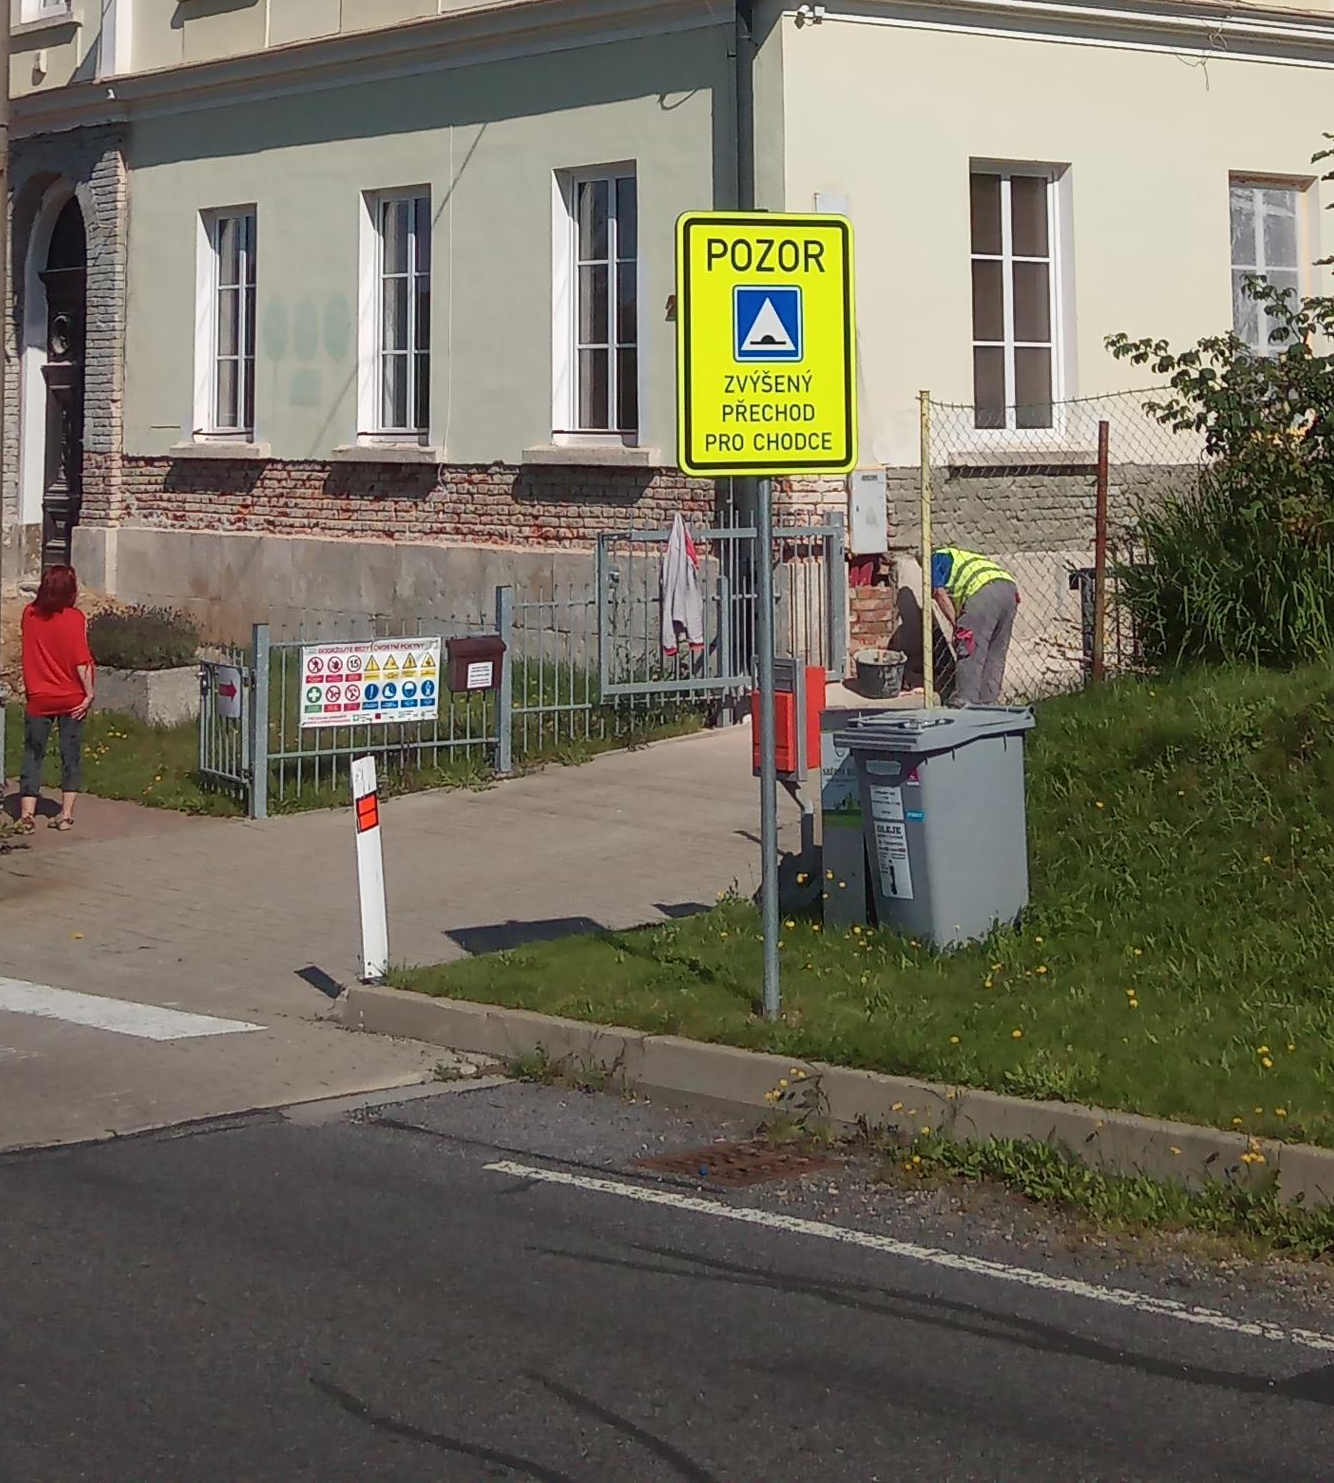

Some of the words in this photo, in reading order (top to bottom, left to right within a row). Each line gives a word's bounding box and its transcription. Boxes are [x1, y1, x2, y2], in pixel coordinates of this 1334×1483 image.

[706, 238, 826, 273] POZOR
[723, 369, 813, 394] ZVÝŠENÝ
[722, 399, 815, 423] PŘECHOD
[705, 433, 744, 452] PRO
[753, 432, 833, 451] CHODCE
[349, 659, 359, 668] 15
